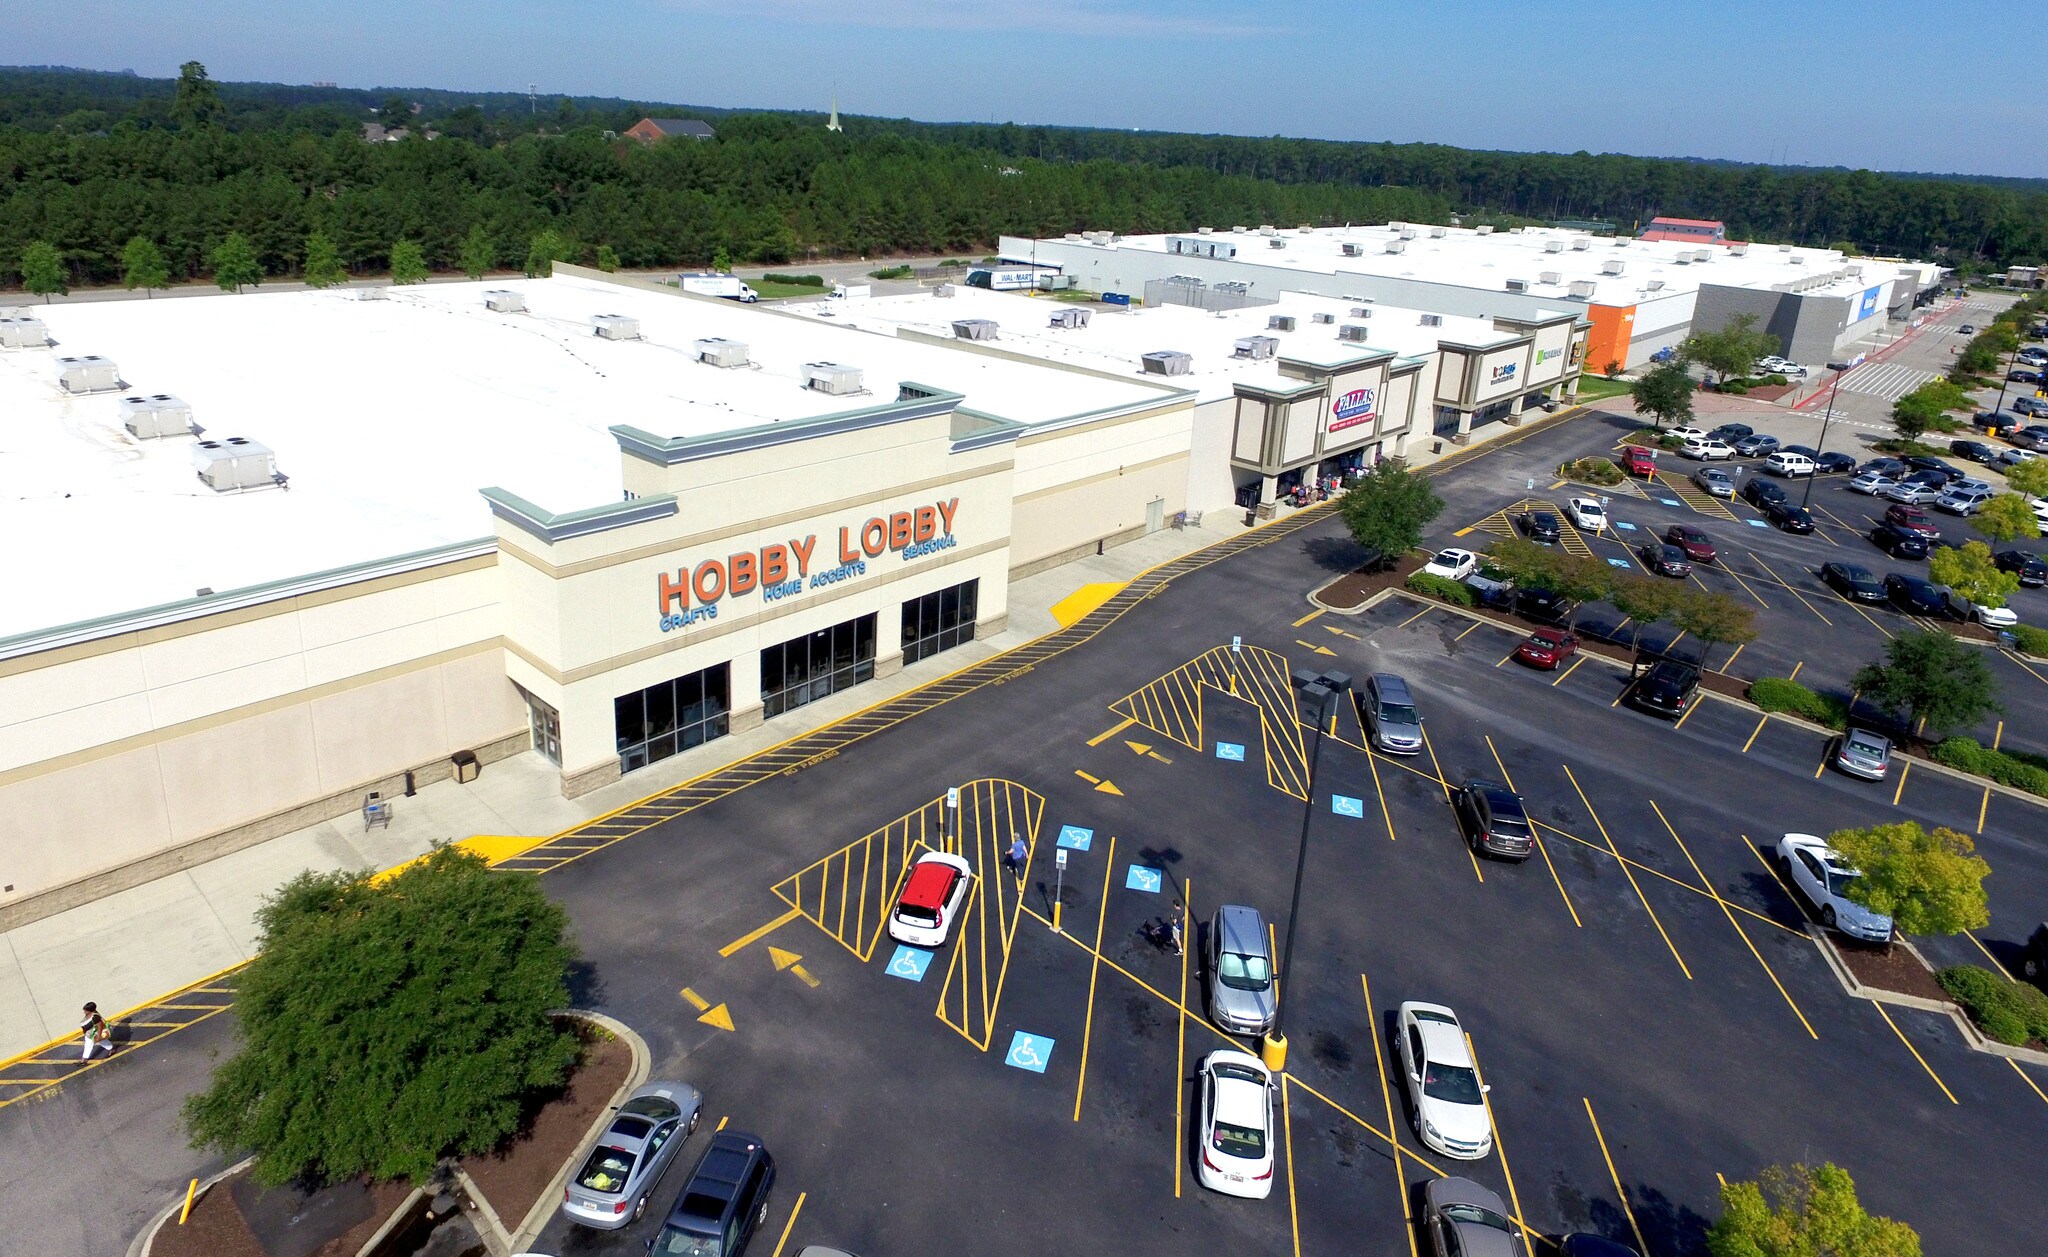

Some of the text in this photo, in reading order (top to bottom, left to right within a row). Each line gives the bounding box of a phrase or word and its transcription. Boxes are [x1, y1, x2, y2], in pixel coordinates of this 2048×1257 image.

[1336, 389, 1374, 413] FALLAS
[658, 496, 960, 616] HOBBY LOBBY
[902, 534, 957, 561] SEASONAL
[763, 560, 867, 603] HOME ACCENTS
[659, 603, 719, 633] CRAFTS
[783, 749, 841, 777] NO PARKING
